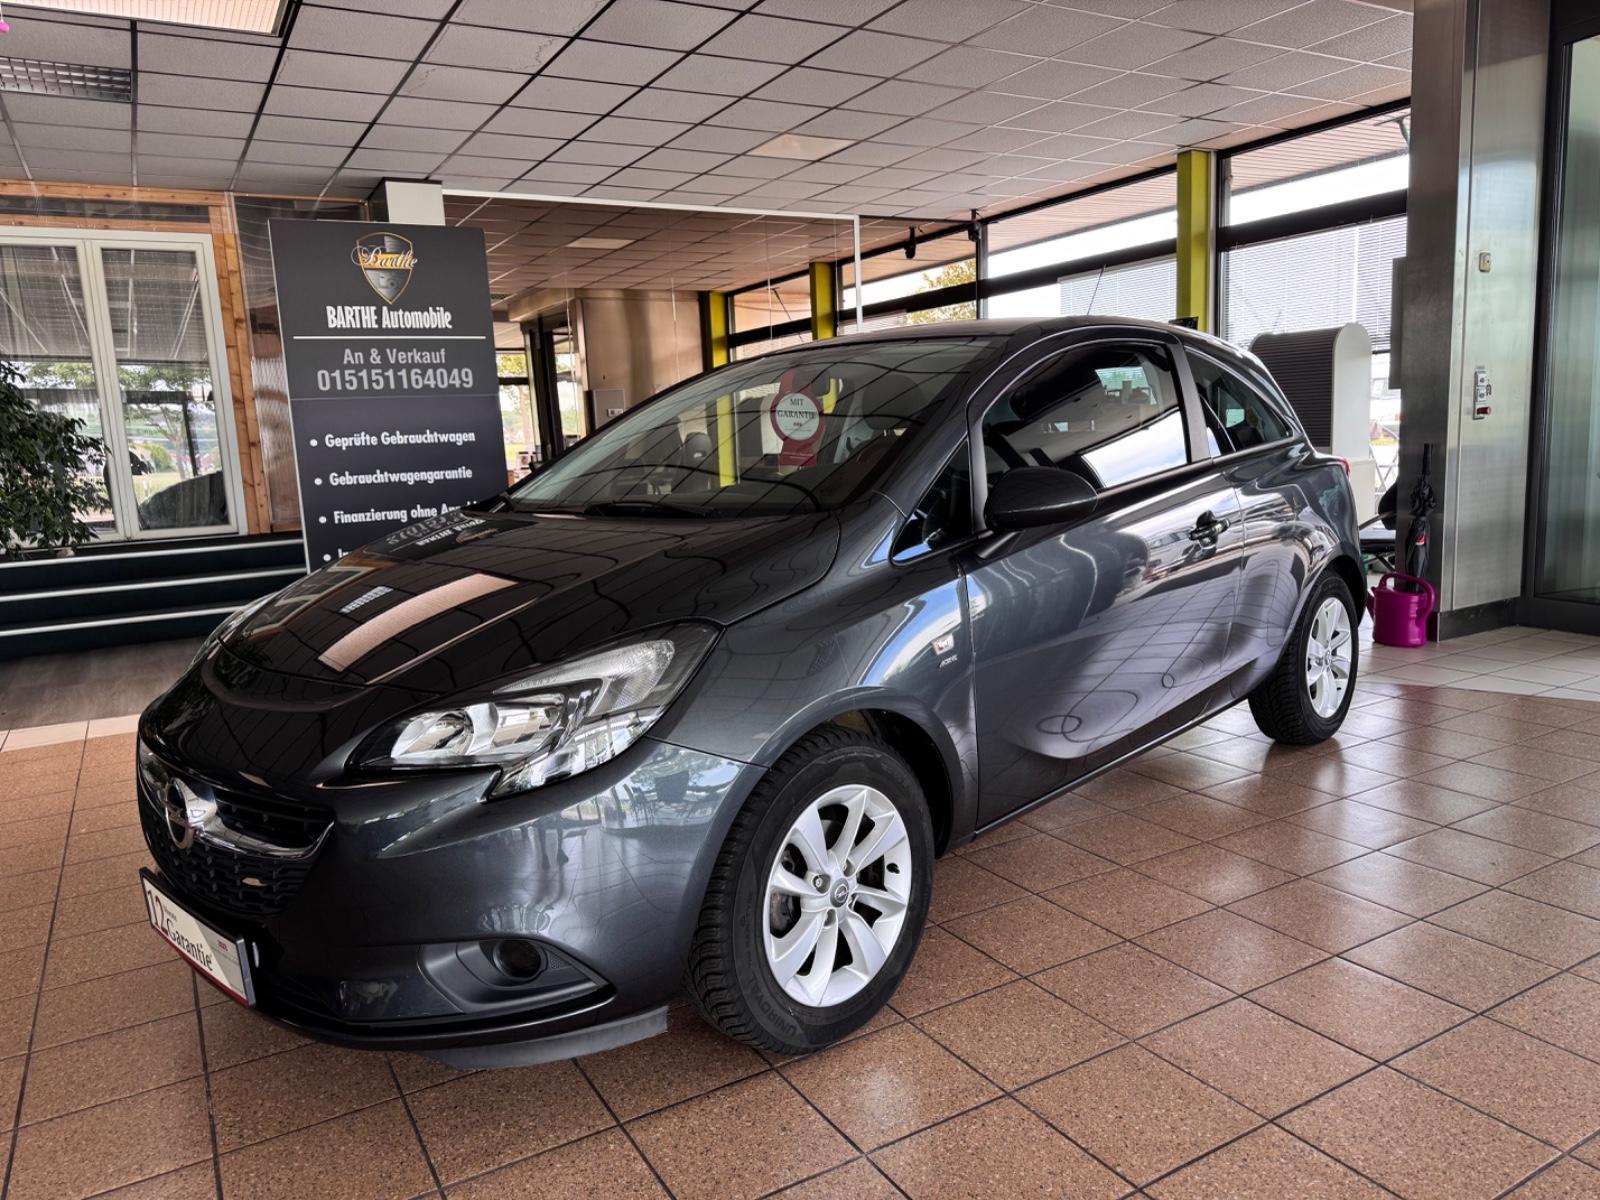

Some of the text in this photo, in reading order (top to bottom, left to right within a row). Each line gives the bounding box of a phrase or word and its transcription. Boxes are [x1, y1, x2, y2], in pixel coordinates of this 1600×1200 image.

[326, 305, 453, 329] BARTHE Automobile
[343, 348, 446, 365] An & Verkauf
[316, 367, 474, 391] 015151164049
[790, 398, 804, 406] MIT
[324, 430, 476, 450] Geprüfte Gebrauchtwagen
[329, 466, 473, 486] Gebrauchtwagengarantie
[333, 508, 408, 525] Finanzierung
[410, 504, 438, 519] ohne
[147, 889, 213, 971] 12 Garantie
